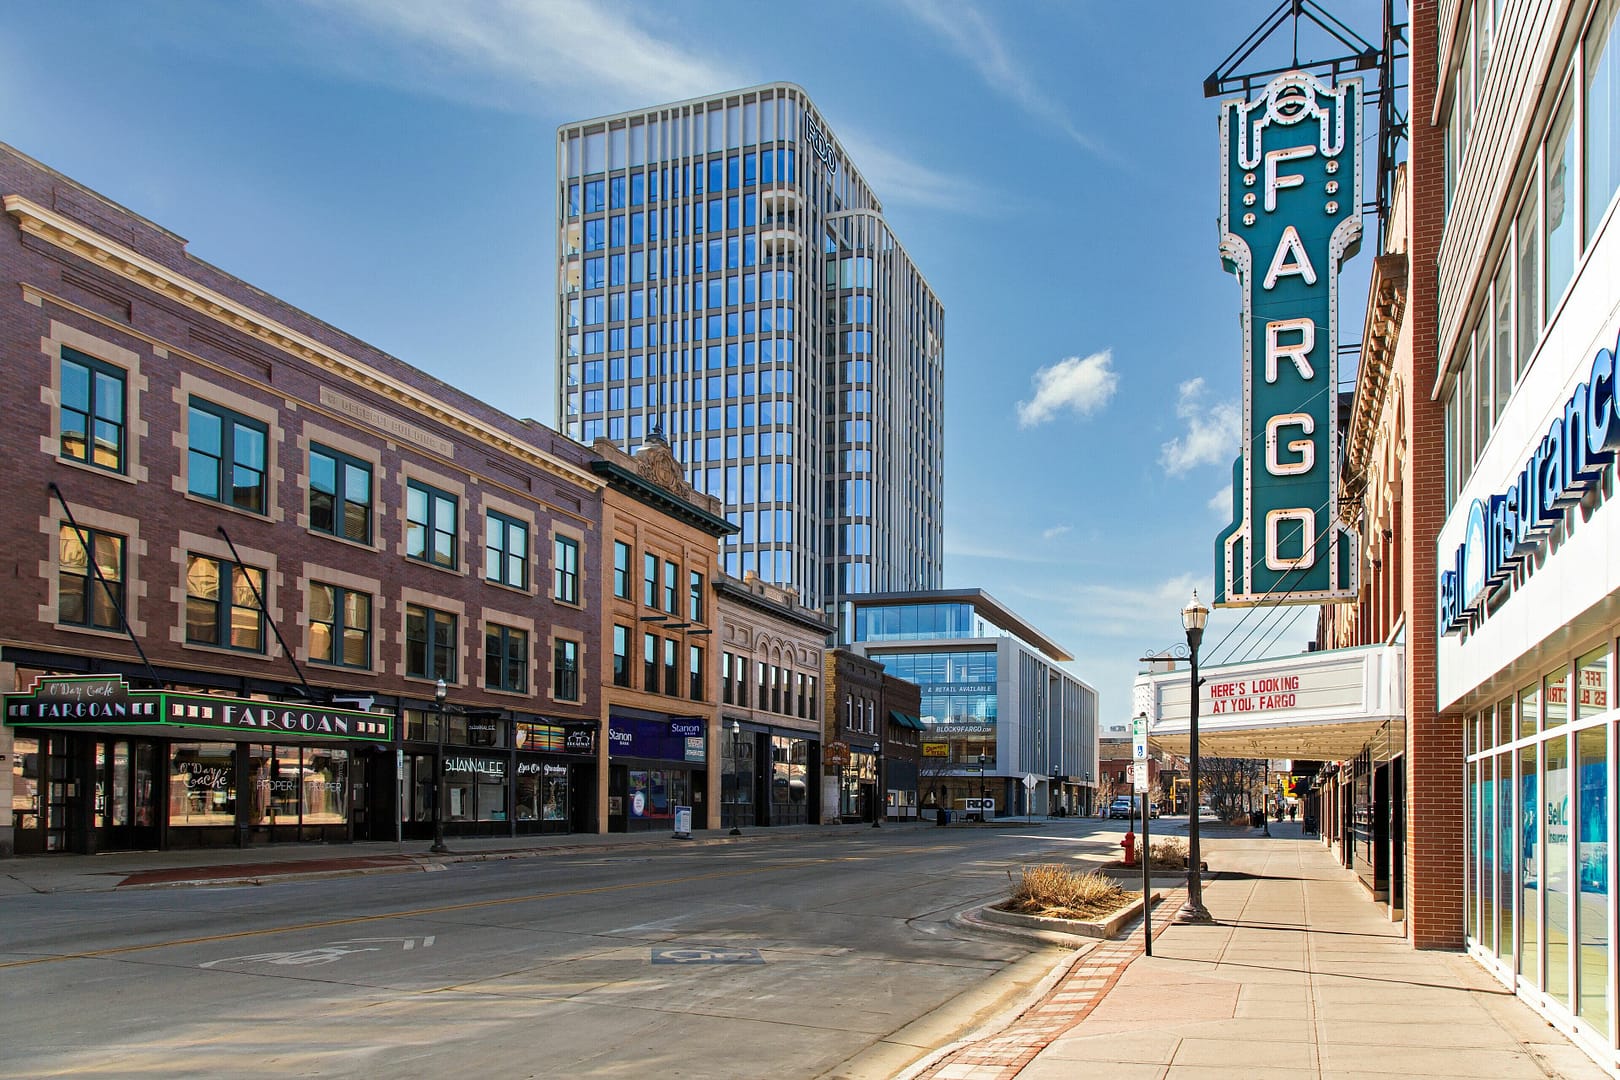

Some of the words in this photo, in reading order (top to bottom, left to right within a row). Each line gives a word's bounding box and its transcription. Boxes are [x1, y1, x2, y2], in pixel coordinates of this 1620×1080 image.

[805, 111, 838, 176] RDO
[1263, 144, 1318, 571] FARGO
[1441, 543, 1466, 637] Bell
[1486, 327, 1620, 584] Insuranc
[1210, 682, 1246, 699] HERE'S
[1252, 676, 1299, 694] LOOKING
[38, 702, 127, 718] FARGOAN
[1213, 700, 1227, 714] AT
[1231, 697, 1255, 713] YOU,
[1260, 693, 1296, 710] FARGO
[222, 705, 348, 734] FARGOAN
[256, 780, 293, 791] PROPER
[309, 782, 342, 792] PROPER
[967, 799, 994, 809] RDO
